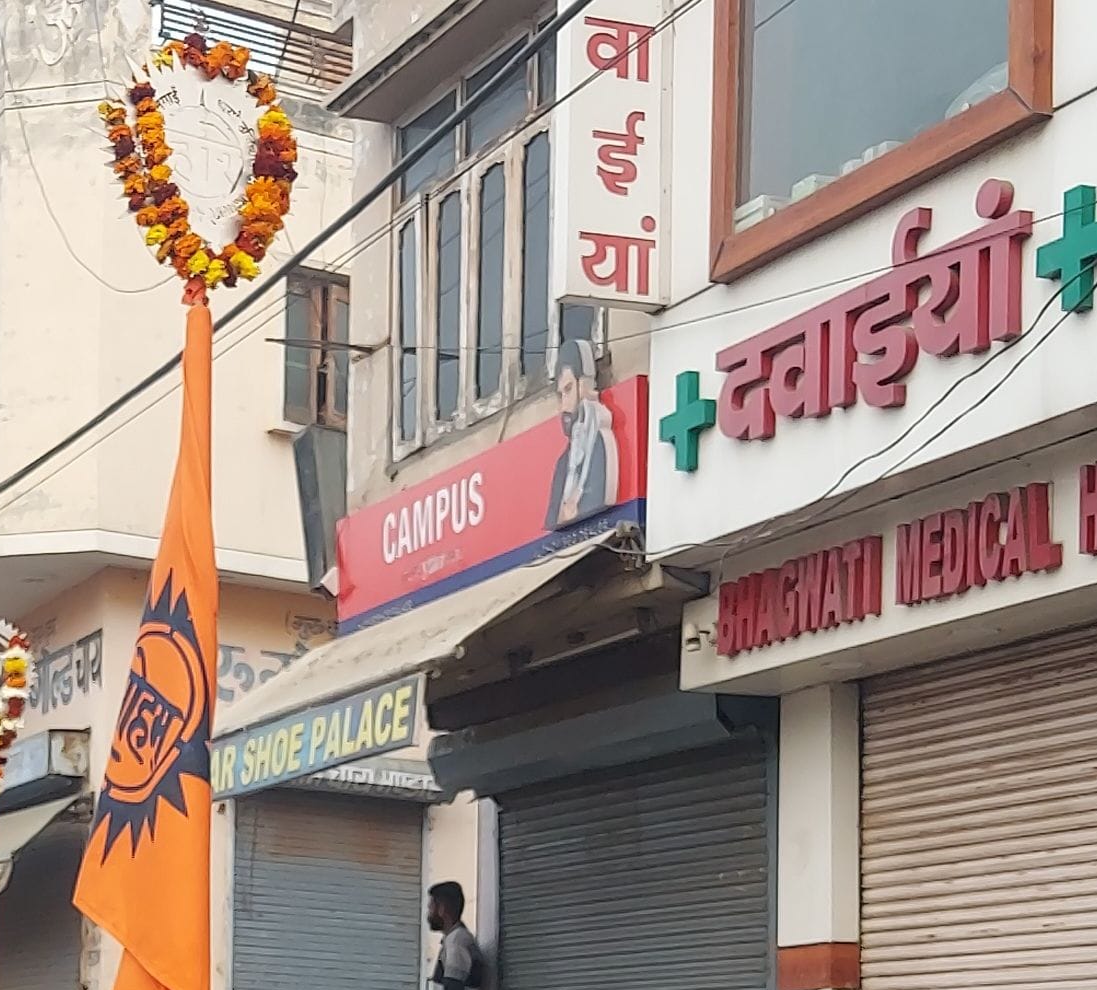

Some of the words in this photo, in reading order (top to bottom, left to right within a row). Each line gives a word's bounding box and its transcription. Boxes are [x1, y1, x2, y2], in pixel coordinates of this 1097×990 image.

[381, 471, 486, 565] CAMPUS
[717, 534, 884, 658] BHAGWATI
[895, 481, 1063, 606] MEDICAL
[240, 722, 305, 787] SHOE
[308, 685, 413, 768] PALACE
